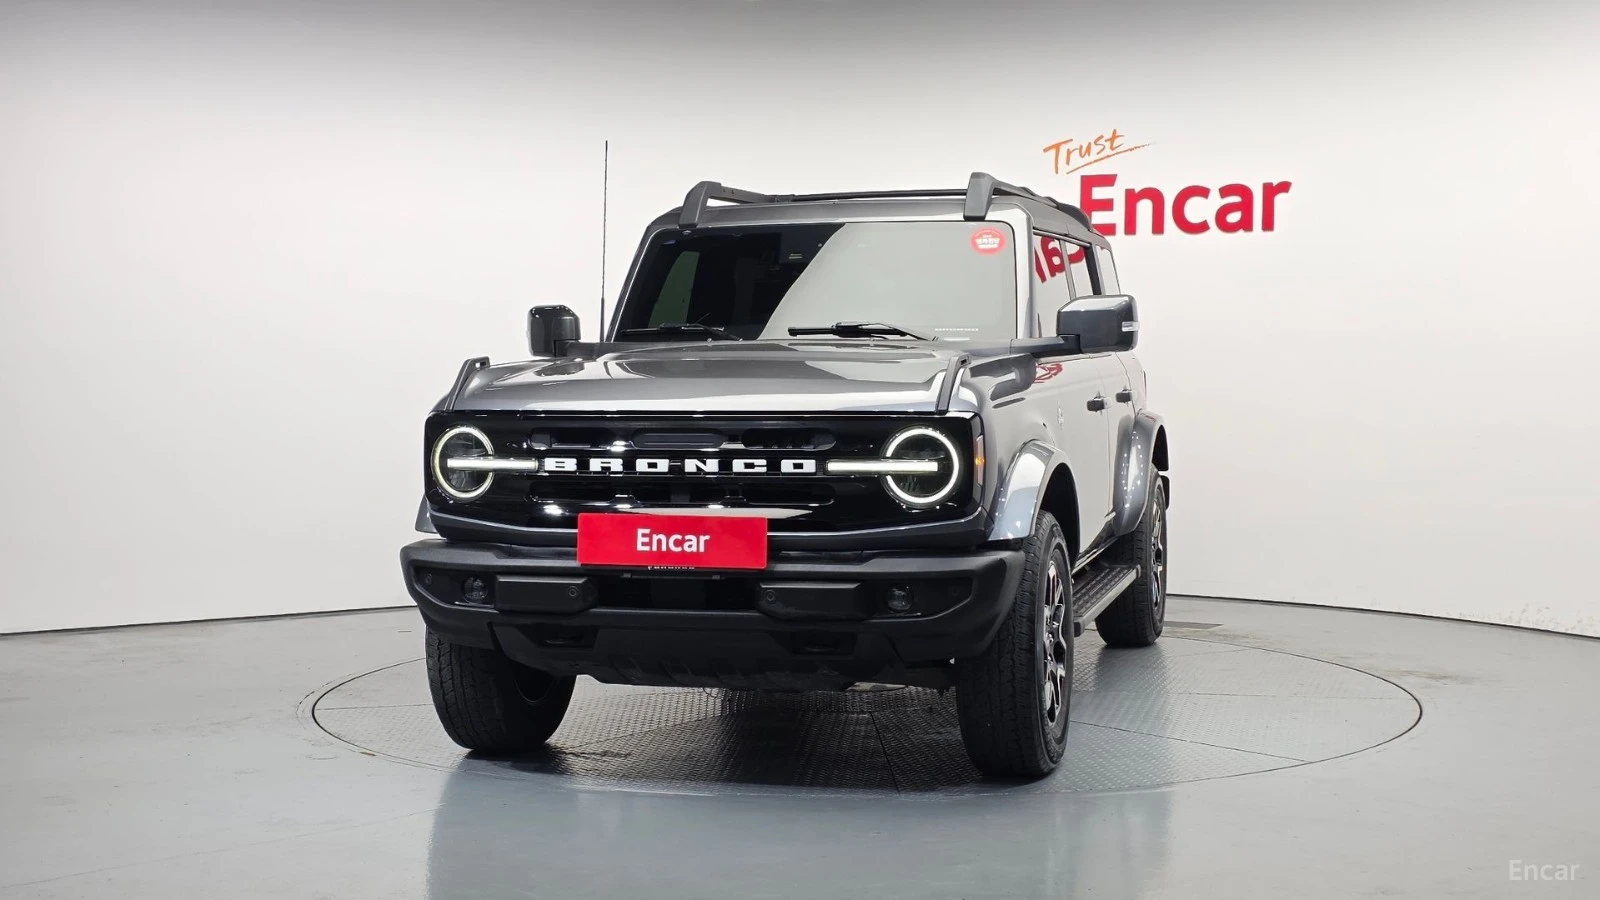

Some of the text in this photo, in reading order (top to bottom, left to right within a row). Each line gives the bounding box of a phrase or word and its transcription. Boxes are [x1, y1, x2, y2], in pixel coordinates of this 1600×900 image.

[1043, 129, 1125, 174] Trust
[1080, 174, 1292, 236] Encar
[544, 458, 816, 473] BRONCO
[636, 528, 711, 553] Encar
